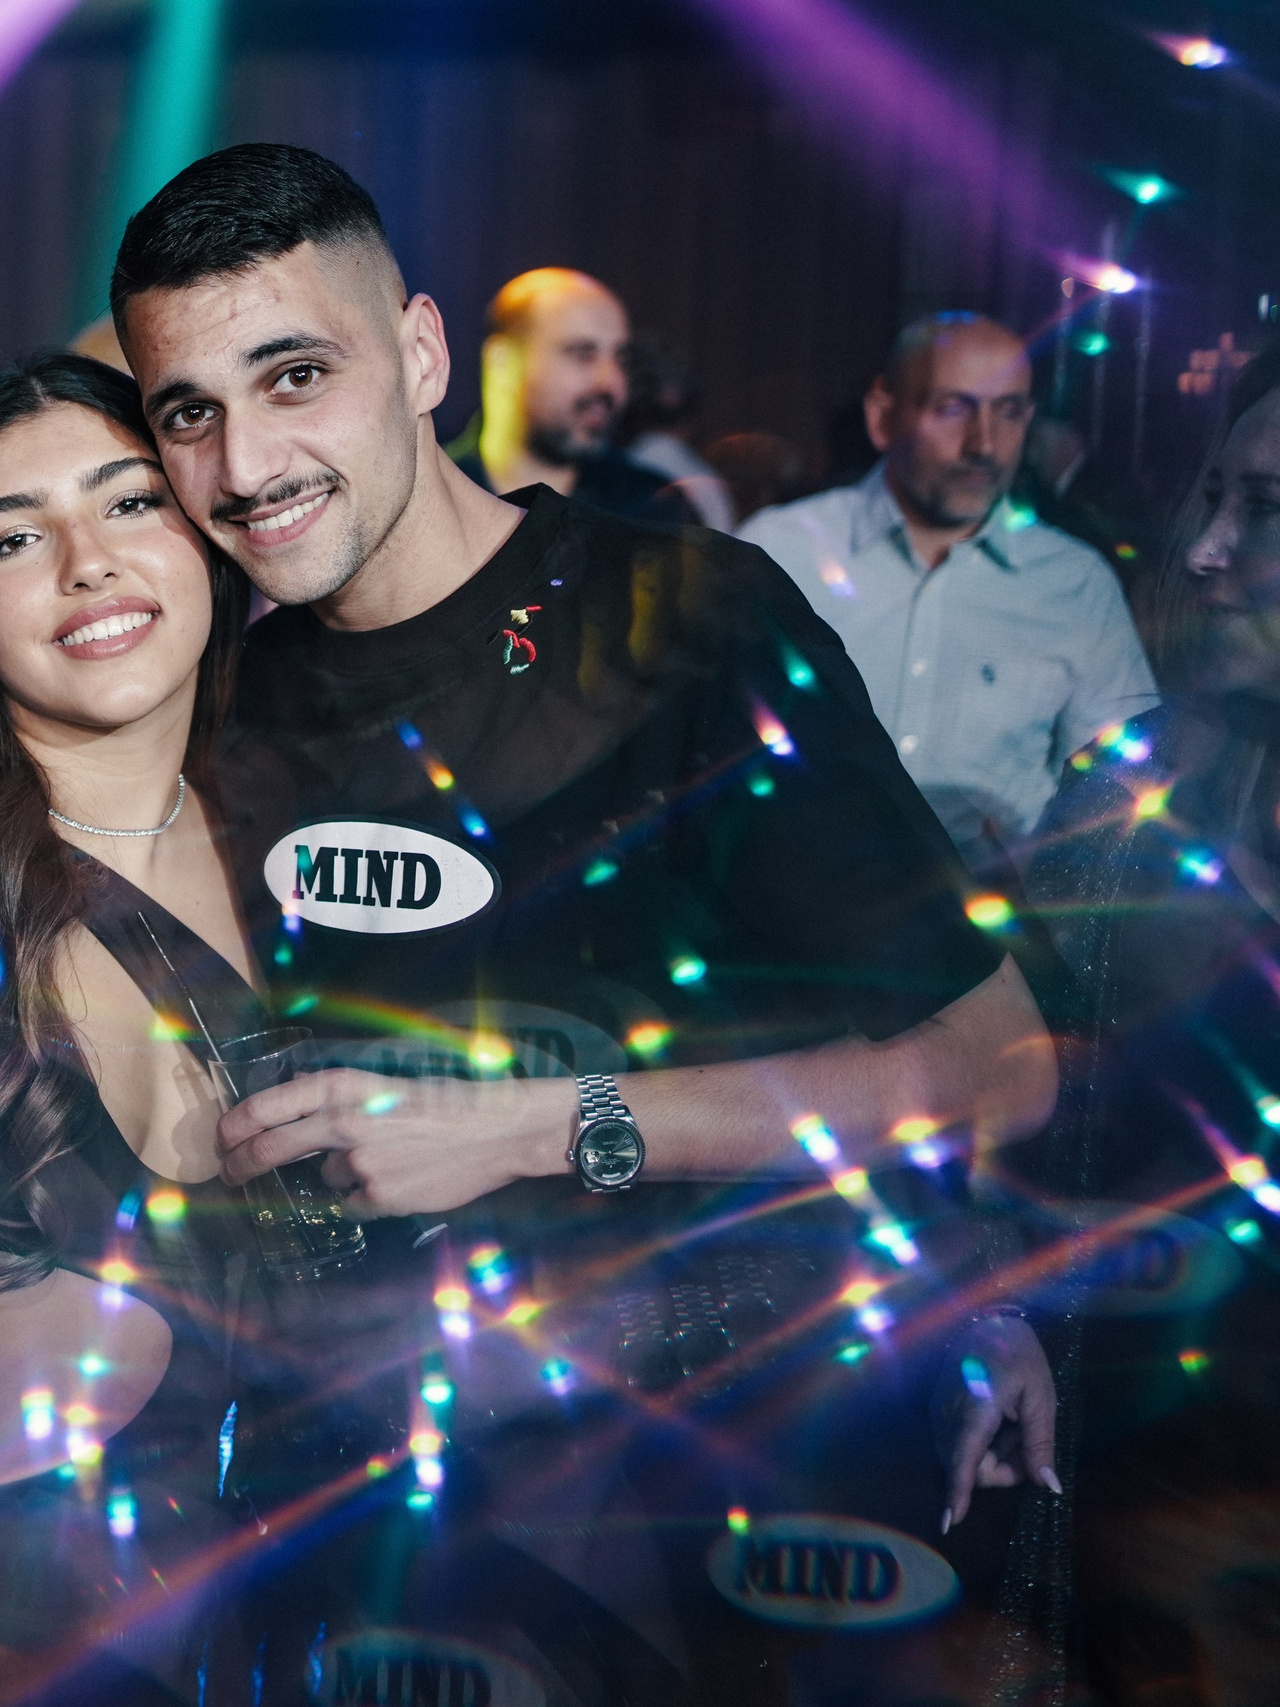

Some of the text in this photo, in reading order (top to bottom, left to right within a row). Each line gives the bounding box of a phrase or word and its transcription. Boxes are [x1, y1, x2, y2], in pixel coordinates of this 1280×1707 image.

[292, 844, 442, 910] MIND
[732, 1534, 901, 1606] MIND
[332, 1649, 491, 1707] MIND
